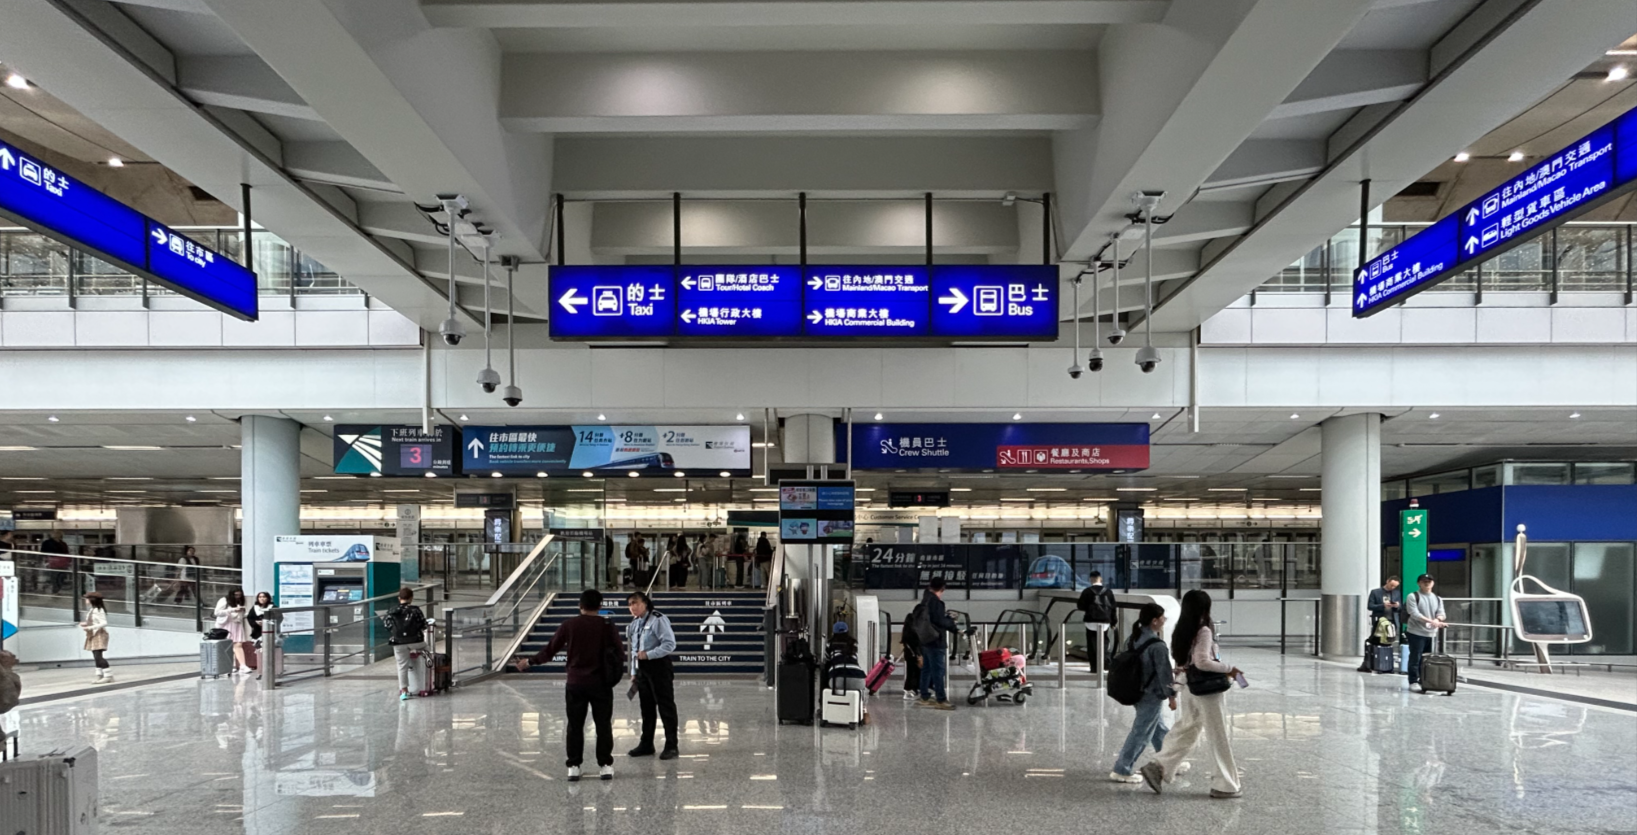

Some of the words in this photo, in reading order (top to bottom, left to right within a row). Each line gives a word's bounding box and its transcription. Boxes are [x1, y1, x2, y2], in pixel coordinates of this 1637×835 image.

[43, 168, 69, 190] 的士
[1501, 168, 1567, 209] Mainland/Macao
[1568, 142, 1612, 173] Transport
[44, 180, 63, 197] Taxi
[1500, 220, 1521, 240] Light
[1521, 210, 1549, 229] Goods
[1548, 191, 1582, 218] Vehicle
[1582, 180, 1606, 200] Area
[186, 240, 214, 264] 往市區
[1382, 250, 1399, 265] 巴士
[186, 252, 194, 260] To
[194, 256, 206, 268] city
[1382, 263, 1394, 273] Bus
[1382, 276, 1416, 299] Commercial
[1417, 262, 1443, 282] Building
[626, 283, 666, 302] 的士
[752, 284, 774, 292] Coach
[842, 284, 896, 292] Mainland/Macao
[898, 284, 929, 292] Transport
[1008, 284, 1049, 302] 巴士
[628, 304, 654, 316] Taxi
[1008, 304, 1033, 316] Bus
[698, 318, 715, 326] HKIA
[716, 318, 737, 326] Tower
[886, 319, 915, 328] Building
[489, 432, 537, 442] 往市區最快
[579, 430, 594, 443] 14
[620, 430, 633, 443] +8
[662, 430, 675, 443] +2
[900, 438, 947, 448] 機員巴士
[410, 446, 422, 464] 3
[899, 448, 920, 456] Crew
[922, 448, 949, 456] Shuttle
